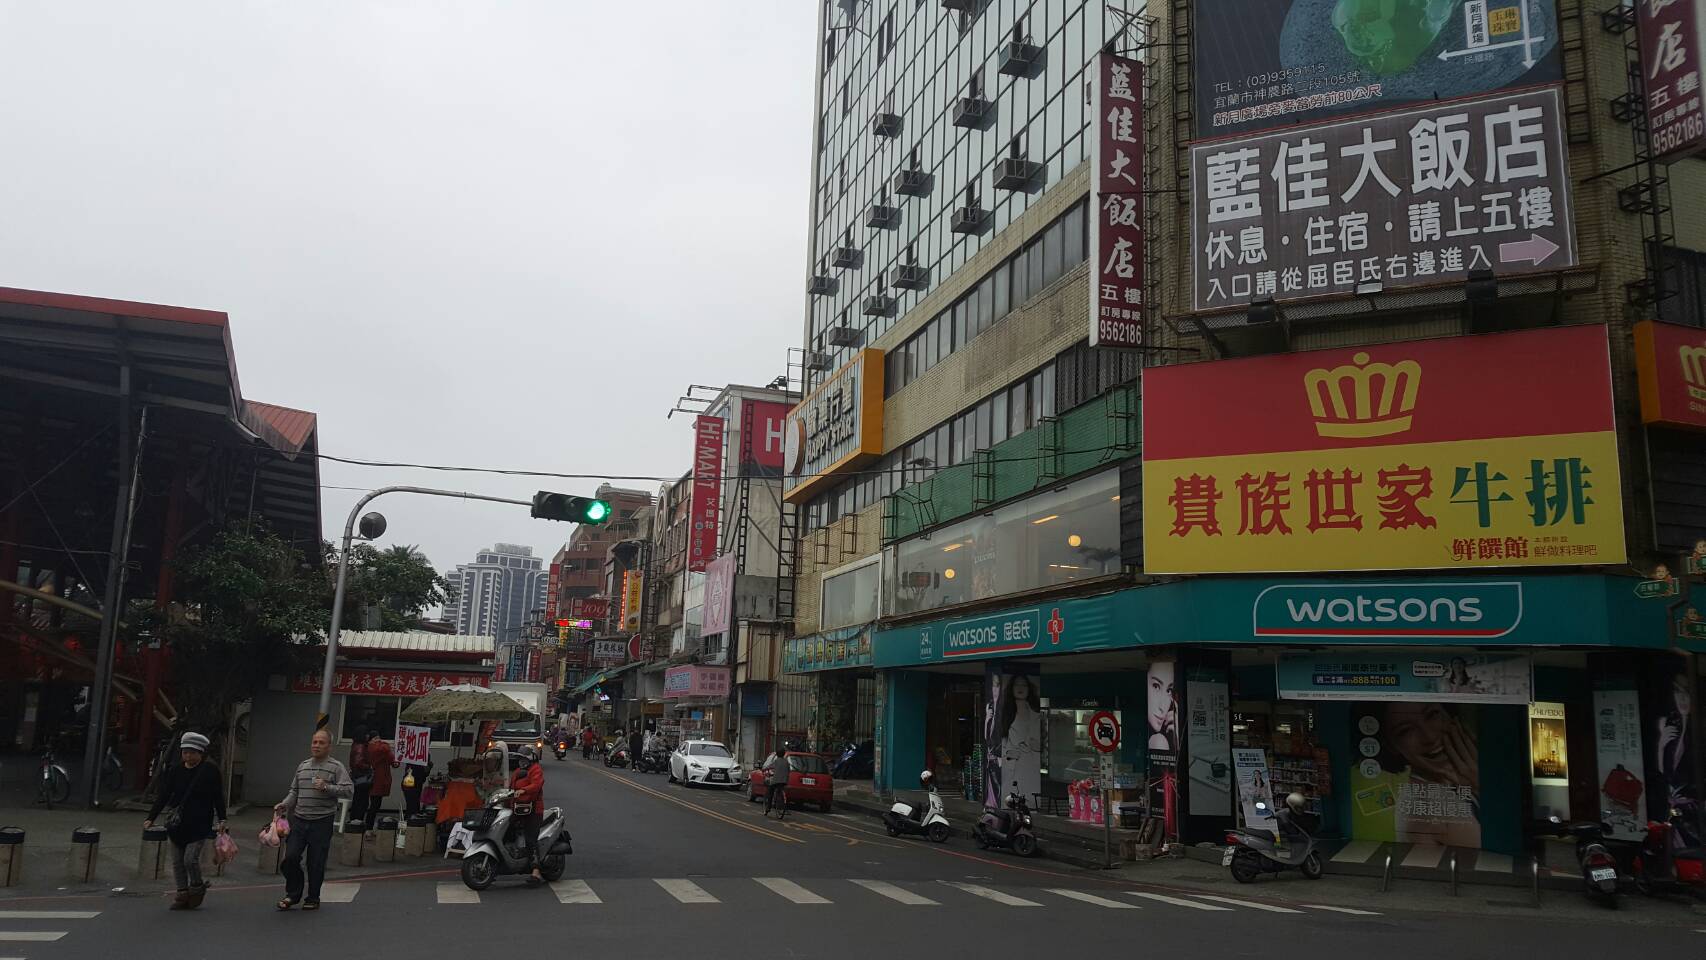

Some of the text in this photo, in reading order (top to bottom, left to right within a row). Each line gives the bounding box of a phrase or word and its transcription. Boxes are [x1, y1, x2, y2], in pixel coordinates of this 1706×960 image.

[1650, 71, 1700, 110] 五樓
[1653, 112, 1704, 155] 9562186
[1103, 61, 1141, 279] 藍佳大飯店
[1206, 104, 1549, 224] 藍佳大飯店
[1206, 244, 1493, 302] 入口請從屈臣氏右邊進入
[1101, 284, 1141, 304] 五樓
[1100, 319, 1142, 345] 9562186
[831, 416, 854, 446] STAR
[1287, 595, 1484, 623] watsons
[949, 619, 1031, 648] watsons 屈臣氏
